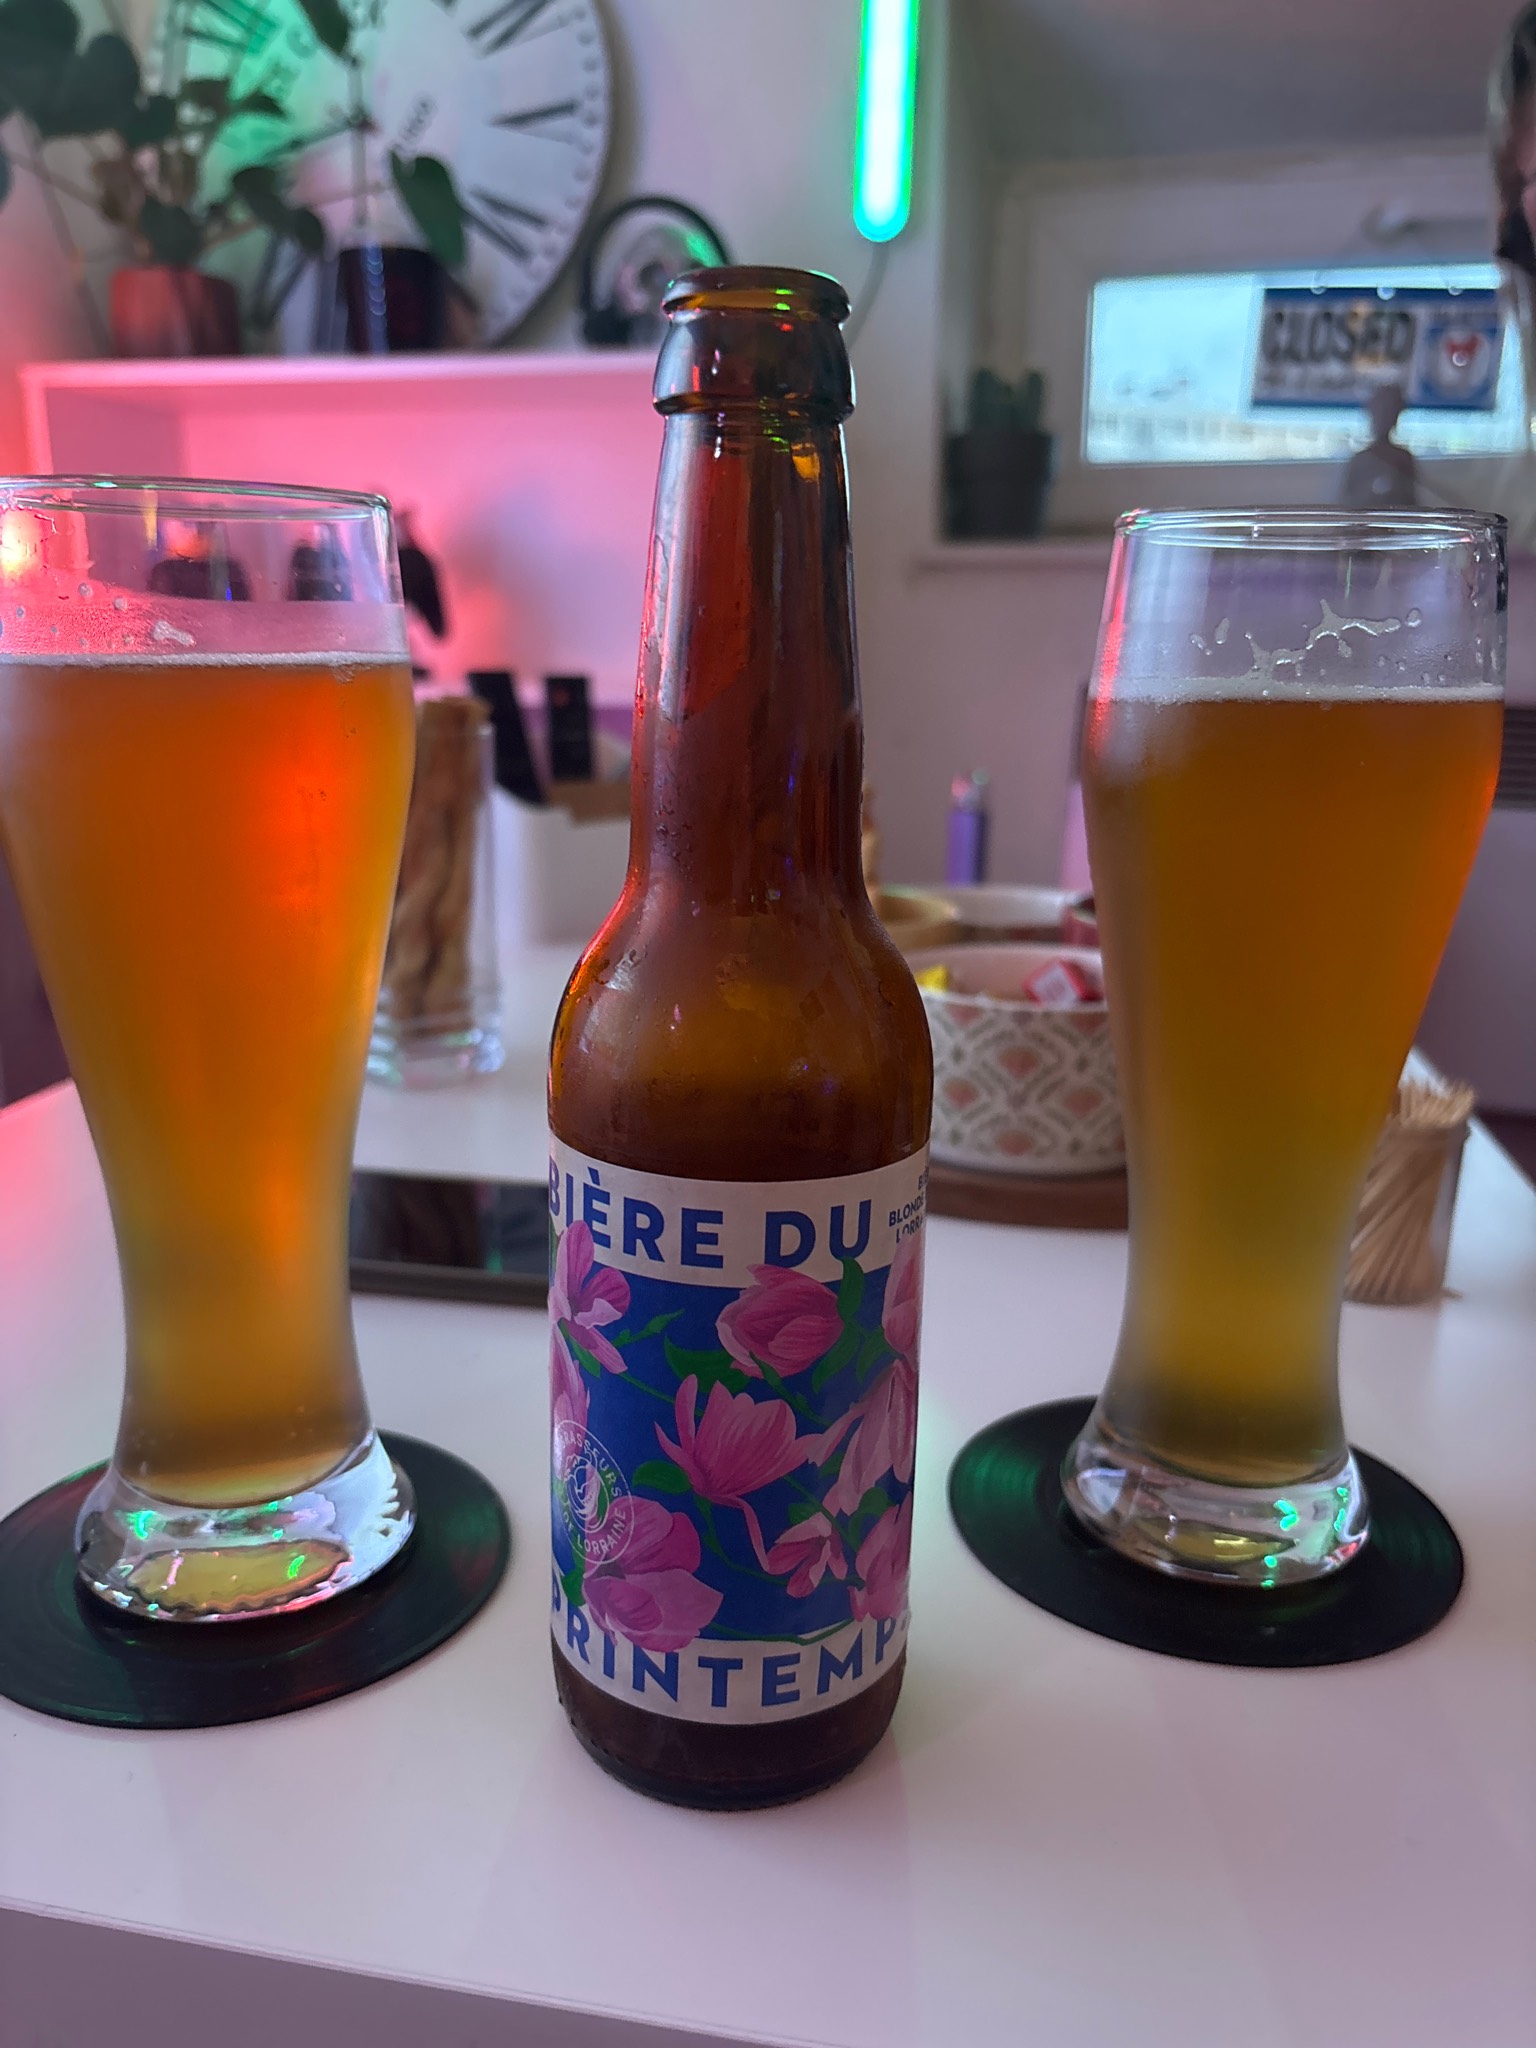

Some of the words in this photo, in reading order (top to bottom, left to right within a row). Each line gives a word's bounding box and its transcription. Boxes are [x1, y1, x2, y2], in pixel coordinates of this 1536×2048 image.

[549, 1155, 724, 1269] BIÈRE
[765, 1200, 872, 1268] DU
[576, 1507, 627, 1555] LORRAINE
[552, 1568, 904, 1708] PRINTEMP
